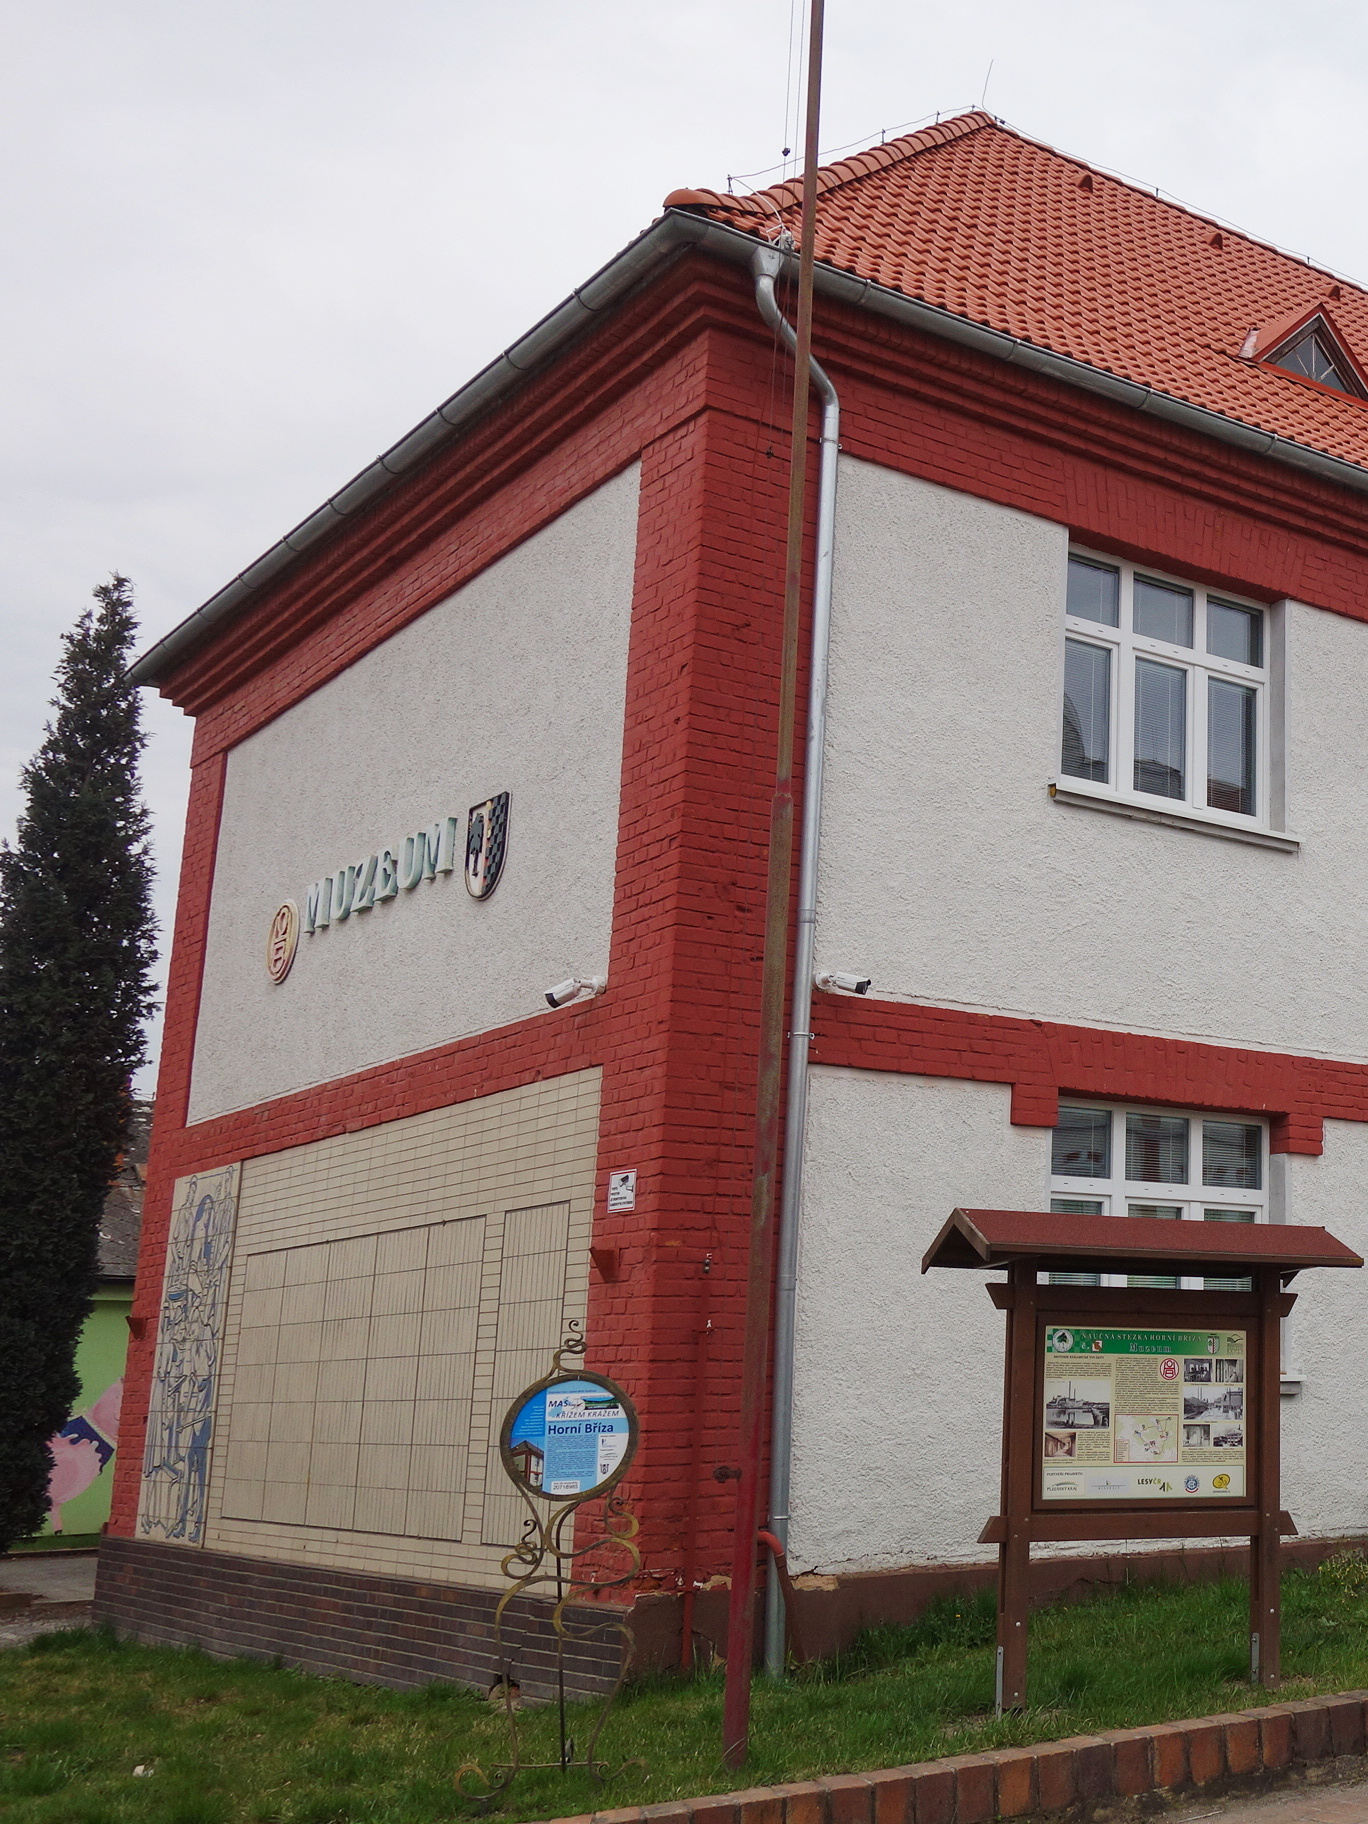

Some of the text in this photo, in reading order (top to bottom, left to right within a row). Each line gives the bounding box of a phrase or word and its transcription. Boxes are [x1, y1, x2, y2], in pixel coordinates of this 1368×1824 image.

[303, 816, 458, 934] MUZEUM
[1081, 1332, 1114, 1340] NAUČNÁ
[1117, 1333, 1148, 1341] STEZKA
[1150, 1333, 1176, 1341] HORNÍ
[1129, 1342, 1172, 1353] Muzeum
[556, 1410, 619, 1419] KŘÍŽEM KRÁŽEM
[548, 1422, 614, 1435] Horní Bříza
